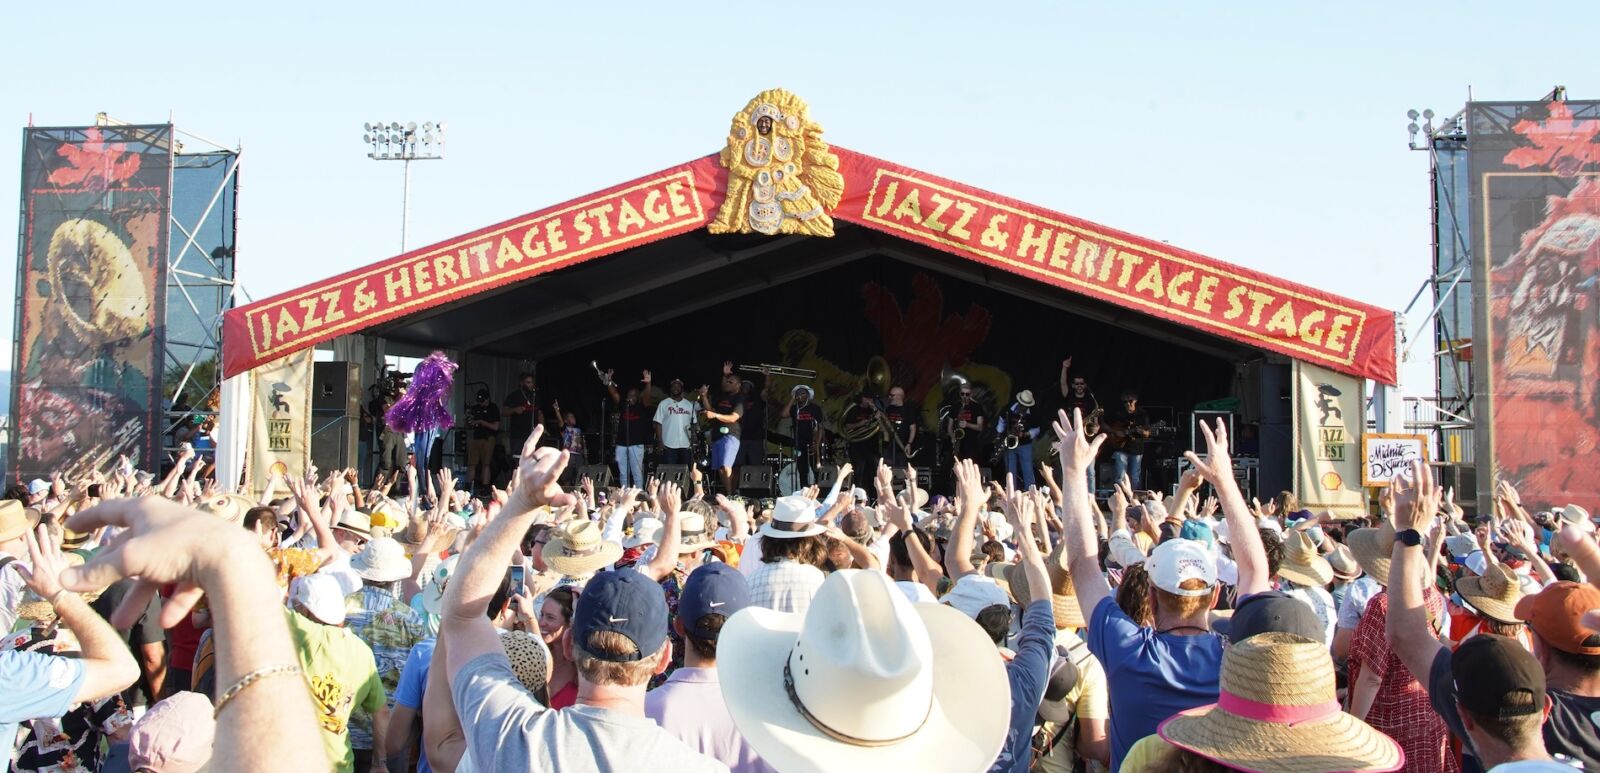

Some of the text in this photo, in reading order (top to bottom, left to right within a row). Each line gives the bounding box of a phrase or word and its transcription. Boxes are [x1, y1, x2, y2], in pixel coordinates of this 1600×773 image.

[261, 181, 691, 350] JAZZ & HERITAGE STAGE
[876, 181, 1353, 352] JAZZ & HERITAGE STAGE
[270, 422, 290, 433] JAZZ
[269, 438, 290, 448] FEST
[1369, 443, 1416, 463] Midnite
